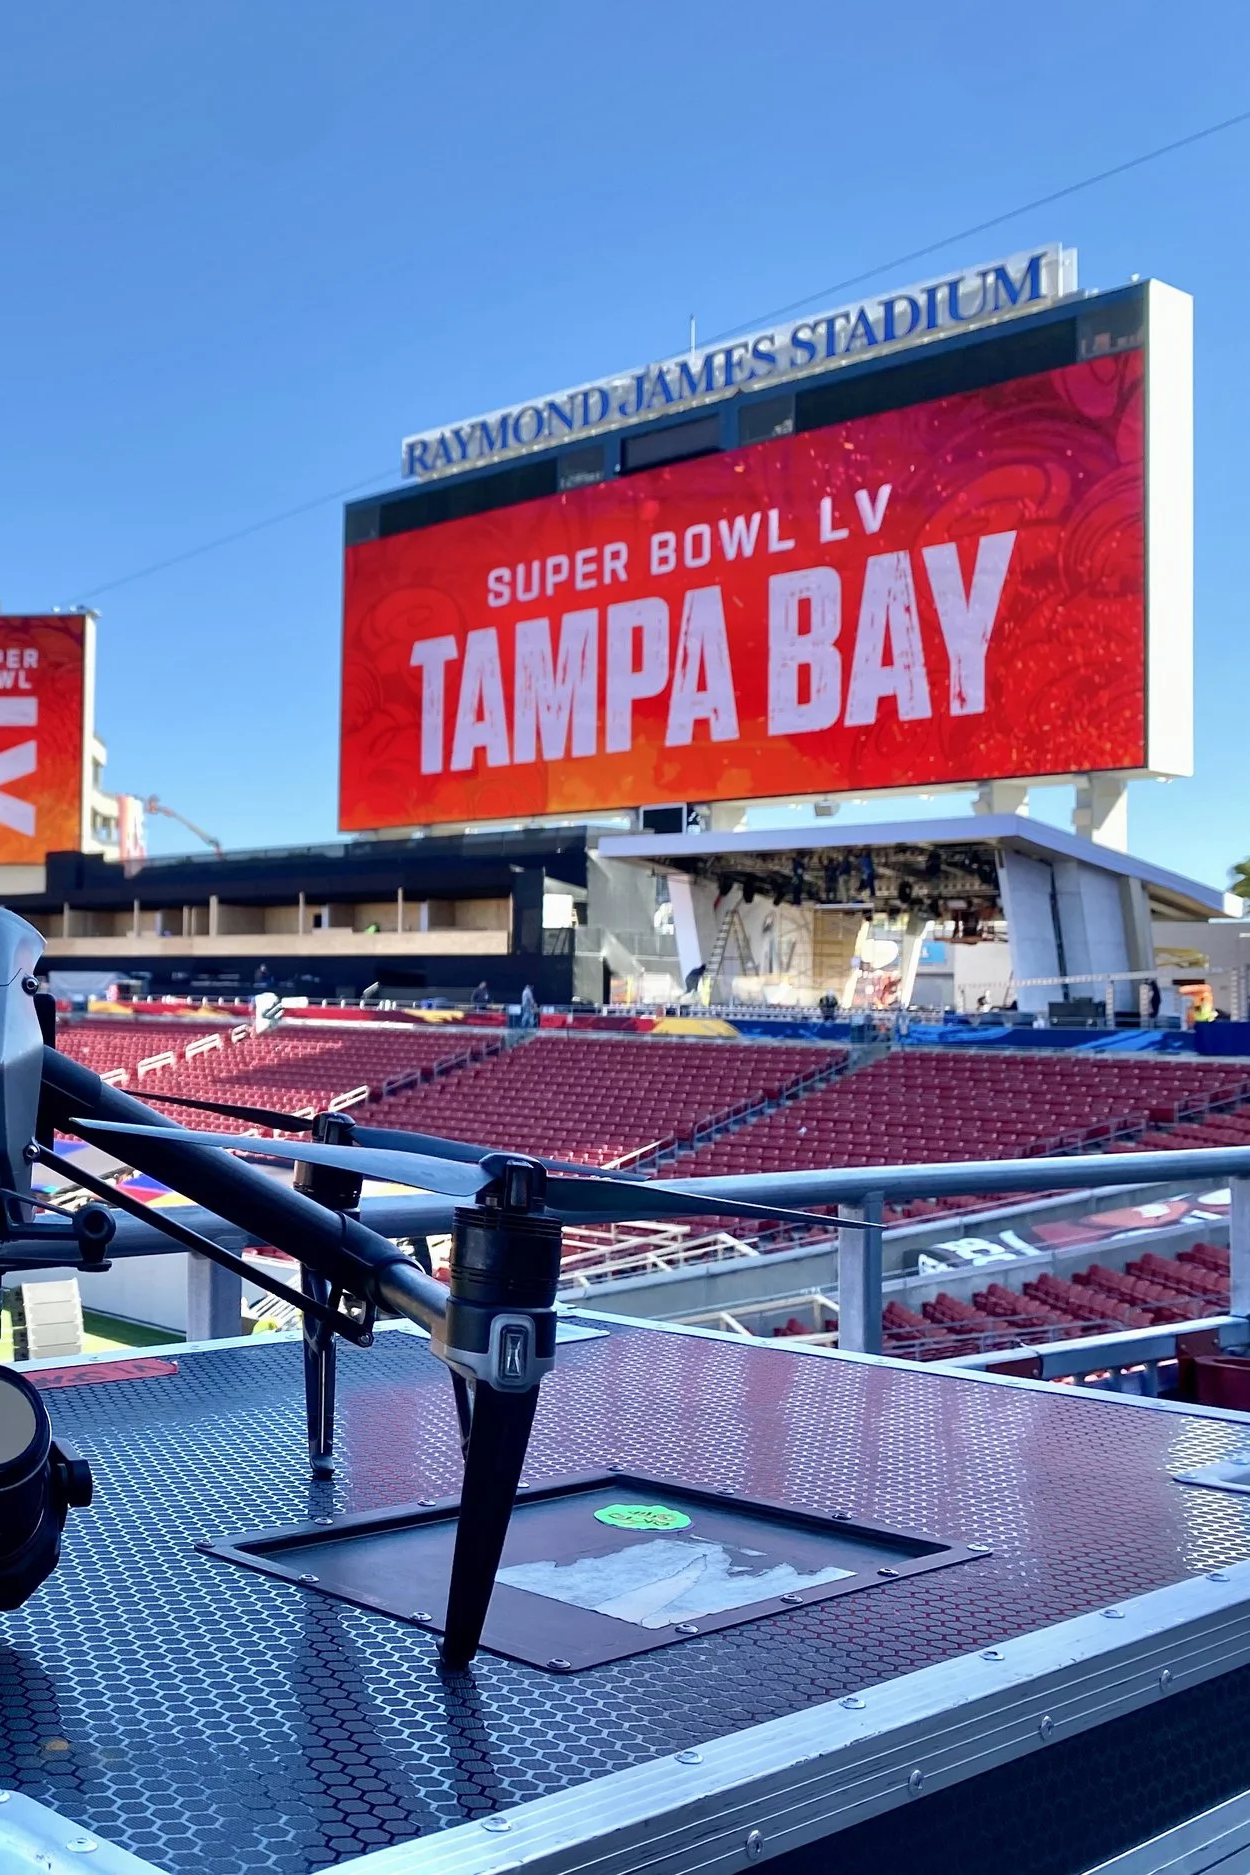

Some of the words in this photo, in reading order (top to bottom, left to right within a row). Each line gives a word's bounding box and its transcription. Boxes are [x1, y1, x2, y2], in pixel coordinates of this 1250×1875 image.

[403, 384, 611, 478] RAYMOND
[617, 333, 777, 417] JAMES
[789, 250, 1049, 368] STADIUM
[409, 584, 741, 776] TAMPA
[767, 529, 1019, 738] BAY
[486, 539, 630, 608] SUPER
[649, 511, 795, 576] BOWL
[818, 482, 895, 544] LV
